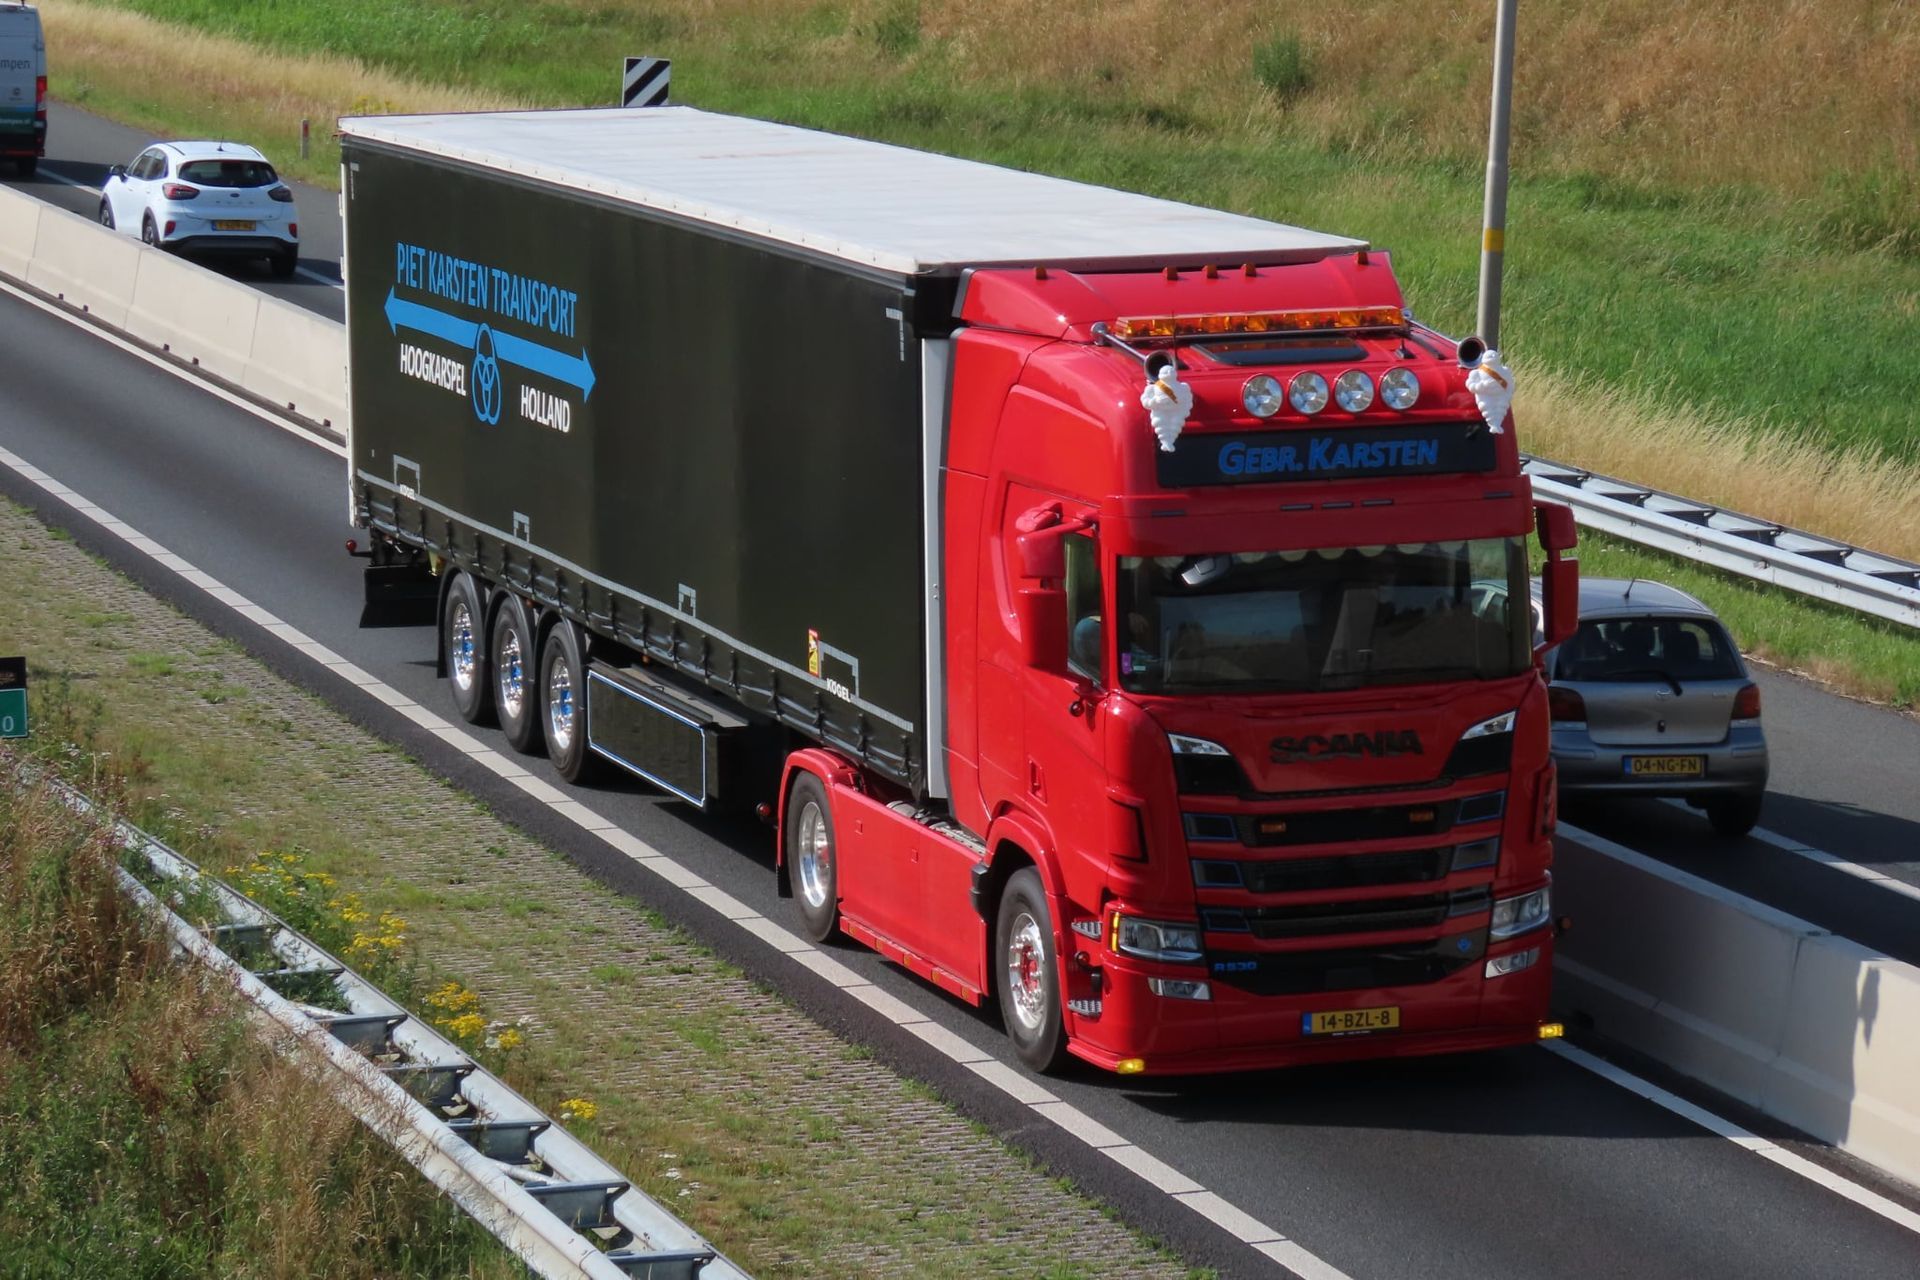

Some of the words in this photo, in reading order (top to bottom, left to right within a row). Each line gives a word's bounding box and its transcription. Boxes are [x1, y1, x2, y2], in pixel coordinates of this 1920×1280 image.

[397, 242, 426, 289] PIET
[429, 250, 488, 310] KARSTEN
[492, 268, 577, 338] TRANSPORT
[400, 343, 467, 396] HOOGKARSPEL
[520, 384, 571, 433] HOLLAND
[1308, 438, 1439, 470] KARSTEN
[1270, 729, 1425, 764] SCANIA
[1633, 757, 1698, 773] 04-NG-FN
[1320, 1010, 1391, 1030] 14-BZL-8
